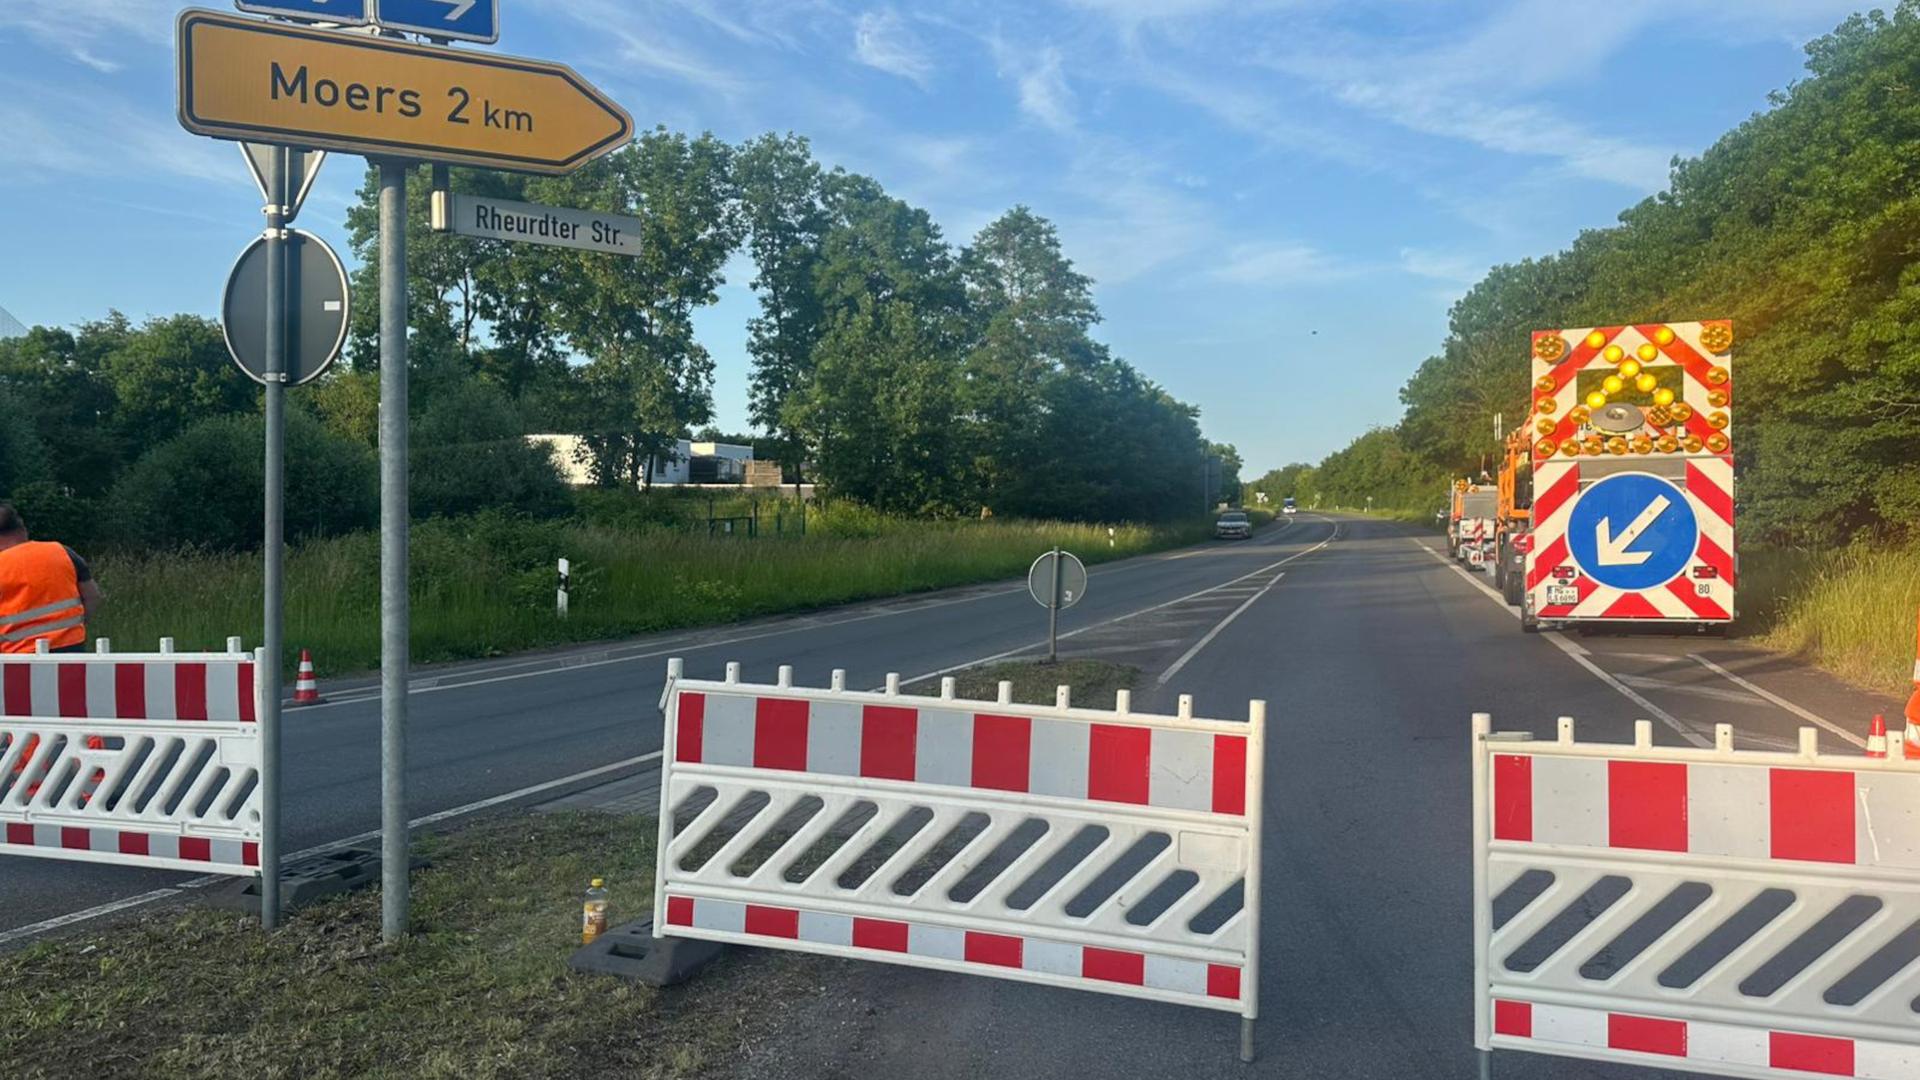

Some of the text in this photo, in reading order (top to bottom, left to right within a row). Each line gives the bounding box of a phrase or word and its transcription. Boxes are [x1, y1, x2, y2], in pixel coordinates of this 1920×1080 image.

[271, 61, 534, 133] Moers 2 km
[475, 203, 625, 248] Rheurdter Str.
[1698, 583, 1710, 594] 80
